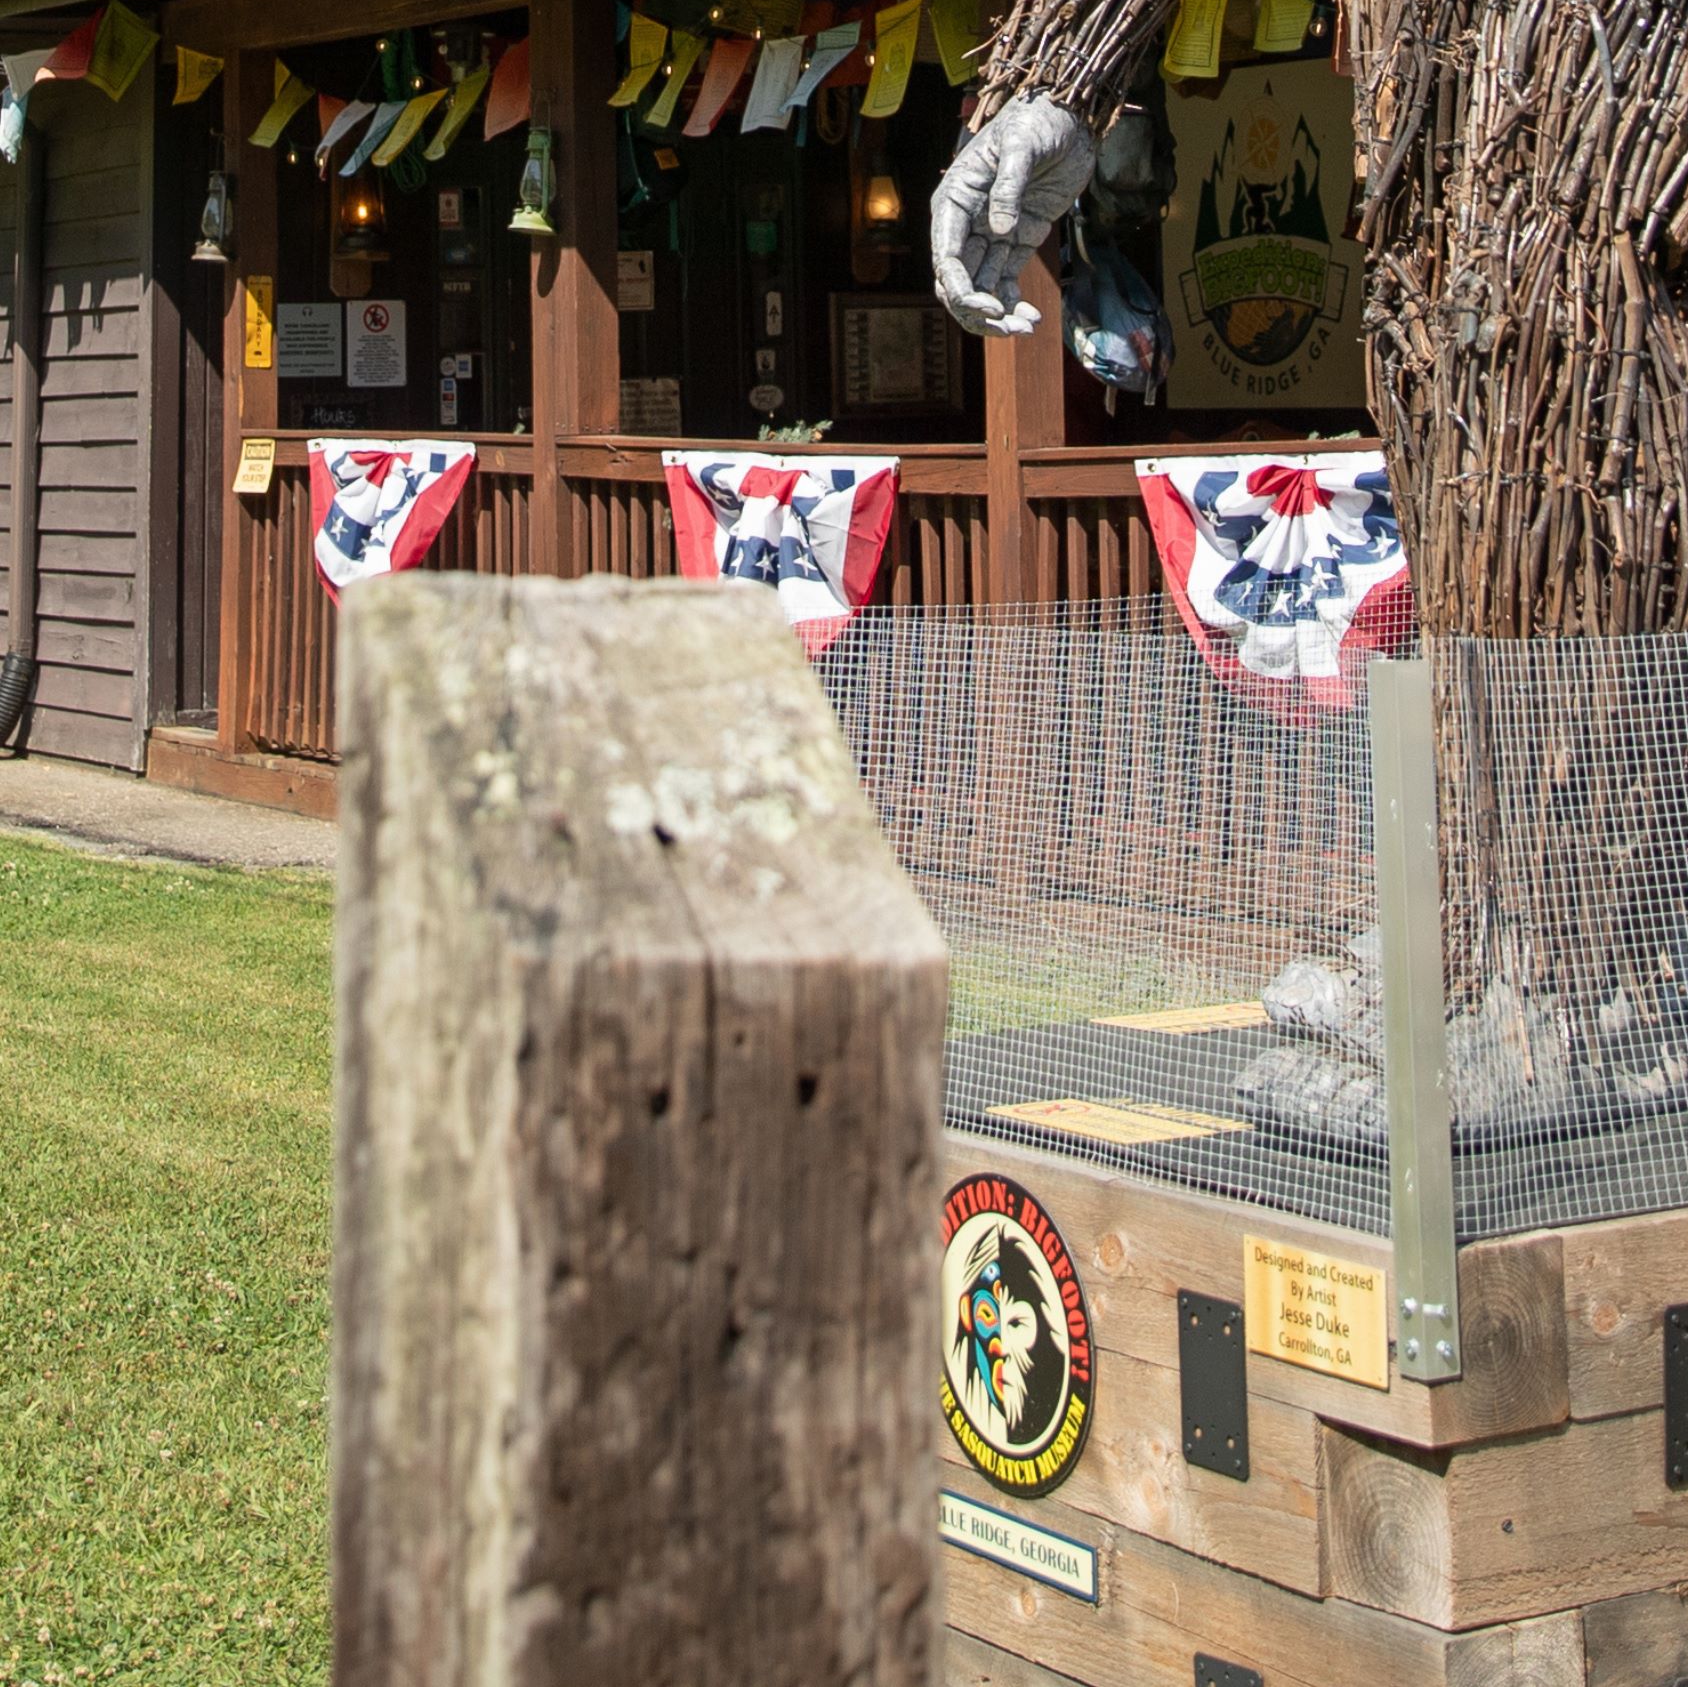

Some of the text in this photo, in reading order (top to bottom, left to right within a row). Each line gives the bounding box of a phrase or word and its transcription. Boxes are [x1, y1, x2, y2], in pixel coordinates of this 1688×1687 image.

[1204, 265, 1325, 307] BIGFOOT!
[1203, 332, 1241, 386] BLUE
[1019, 1197, 1090, 1384] BIGFOOT!
[1254, 1246, 1374, 1291] Designed and Created
[1291, 1280, 1337, 1307] By Artist
[1280, 1302, 1350, 1338] Jesse Duke
[1278, 1331, 1352, 1366] Carrollton, GA
[951, 1408, 1038, 1486] SASQUATCH
[1034, 1392, 1087, 1481] MUSEUM
[971, 1516, 1017, 1555] RIDGE,
[1019, 1535, 1081, 1579] GEORGIA
